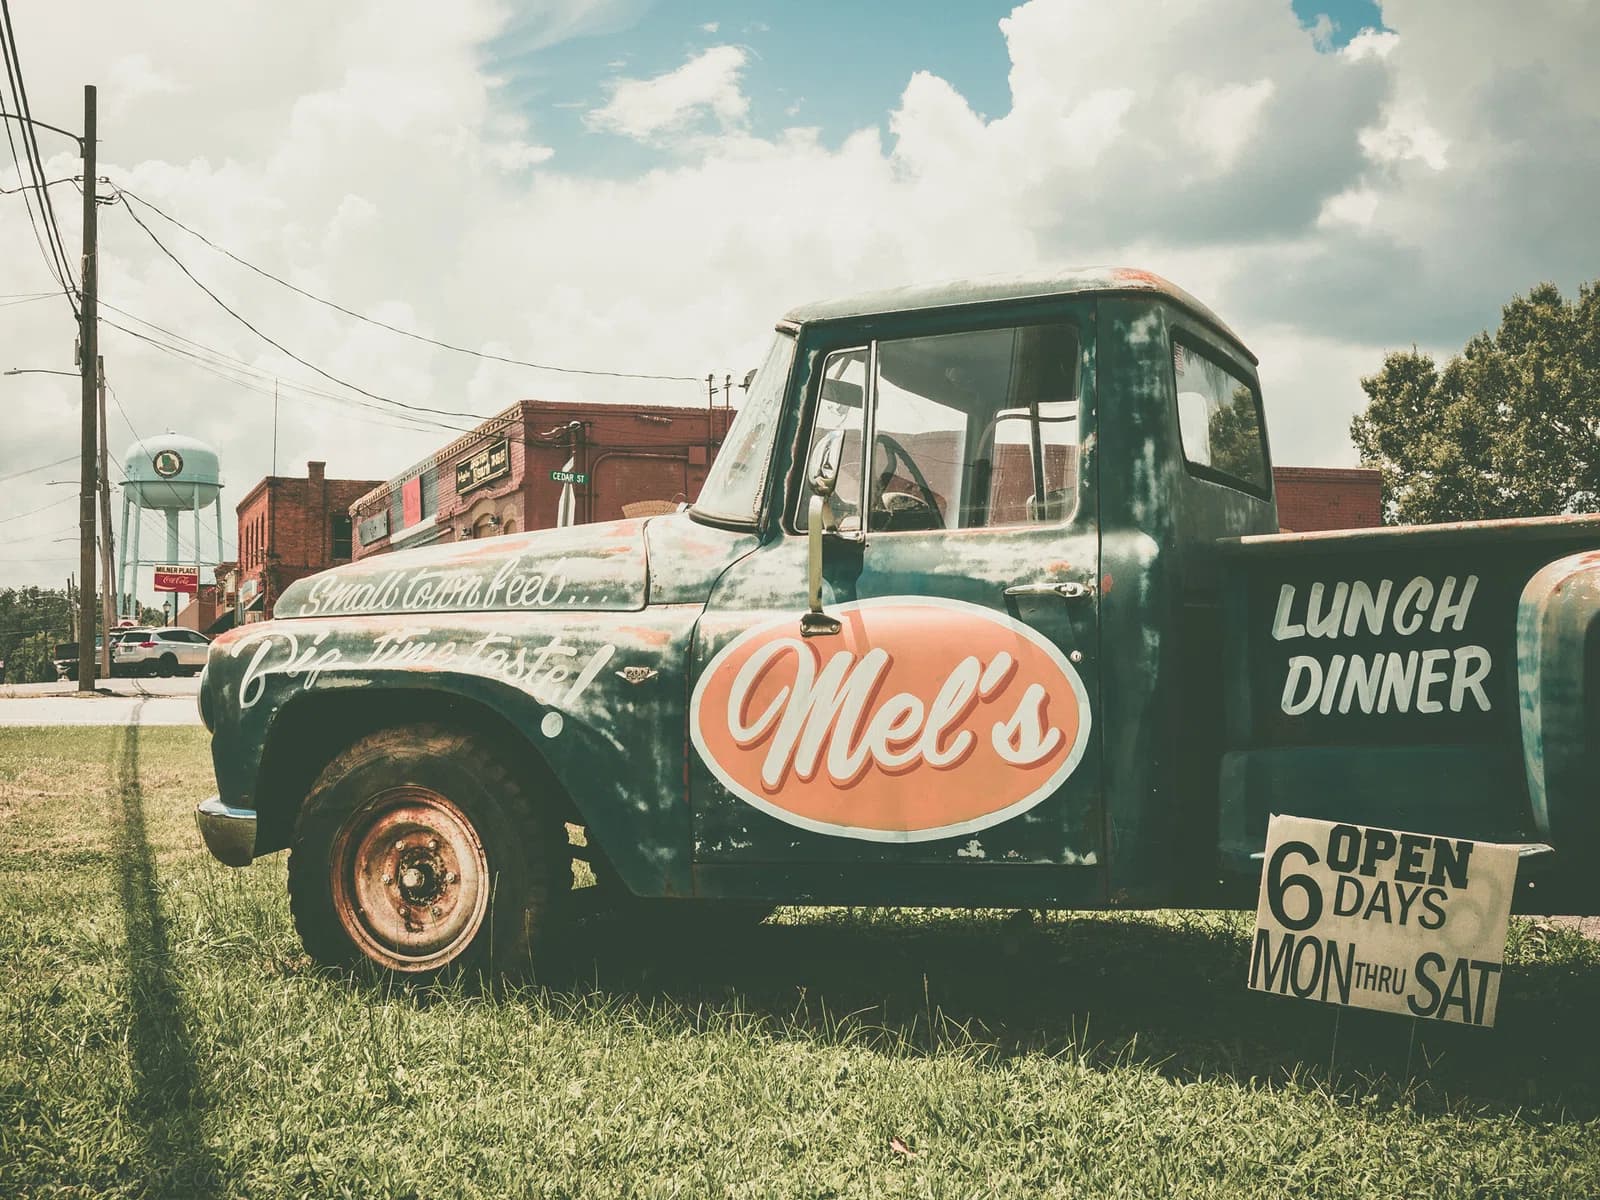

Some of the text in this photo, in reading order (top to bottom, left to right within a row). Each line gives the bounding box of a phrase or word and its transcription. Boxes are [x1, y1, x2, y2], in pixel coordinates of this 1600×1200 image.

[552, 472, 585, 483] CEDAR ST
[300, 572, 406, 617] Small
[403, 568, 482, 610] town
[1272, 574, 1480, 641] LUNCH
[464, 631, 615, 704] taste!
[1280, 645, 1493, 716] DINNER
[728, 637, 1064, 794] Mel's
[1266, 840, 1449, 932] 6 DAYS
[1326, 823, 1474, 890] OPEN
[1250, 928, 1504, 1028] MON THRU SAT
